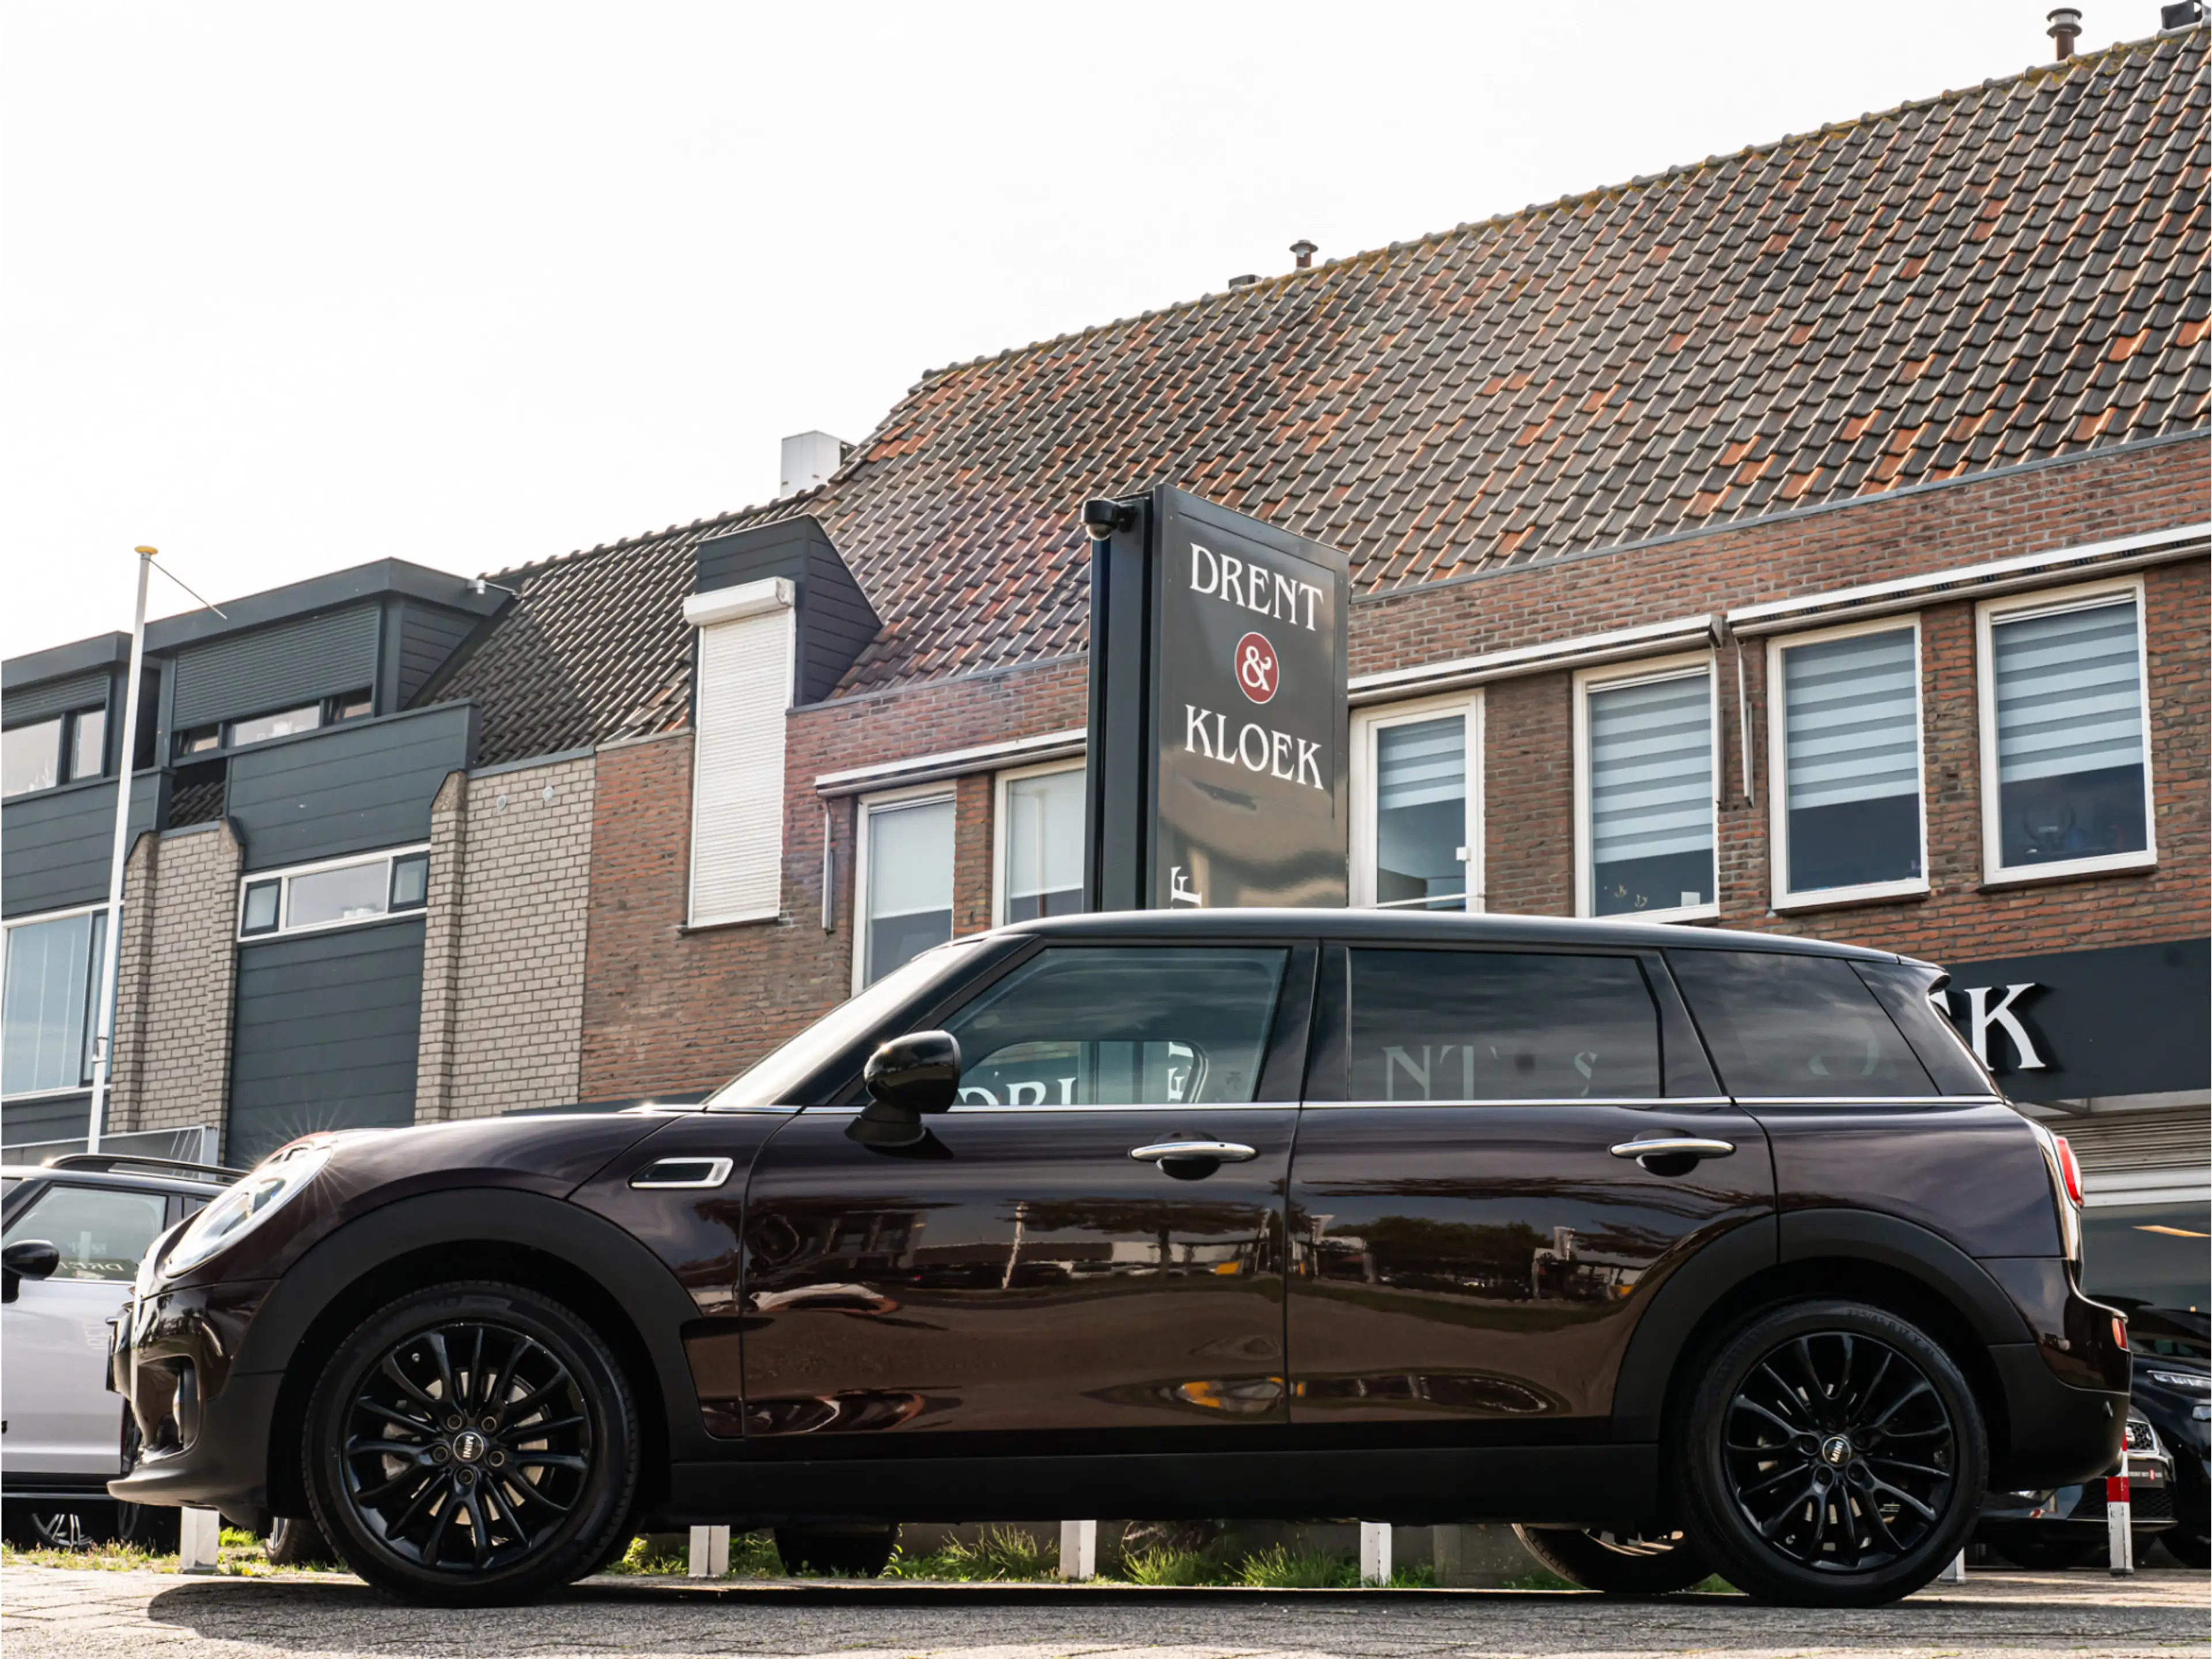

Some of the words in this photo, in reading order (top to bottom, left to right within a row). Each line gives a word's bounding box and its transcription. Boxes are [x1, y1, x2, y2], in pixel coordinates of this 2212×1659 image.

[1190, 542, 1324, 631] DRENT
[1241, 646, 1272, 691] &
[1184, 703, 1324, 790] KLOEK
[463, 1435, 475, 1459] MINI
[1830, 1440, 1844, 1463] MINI
